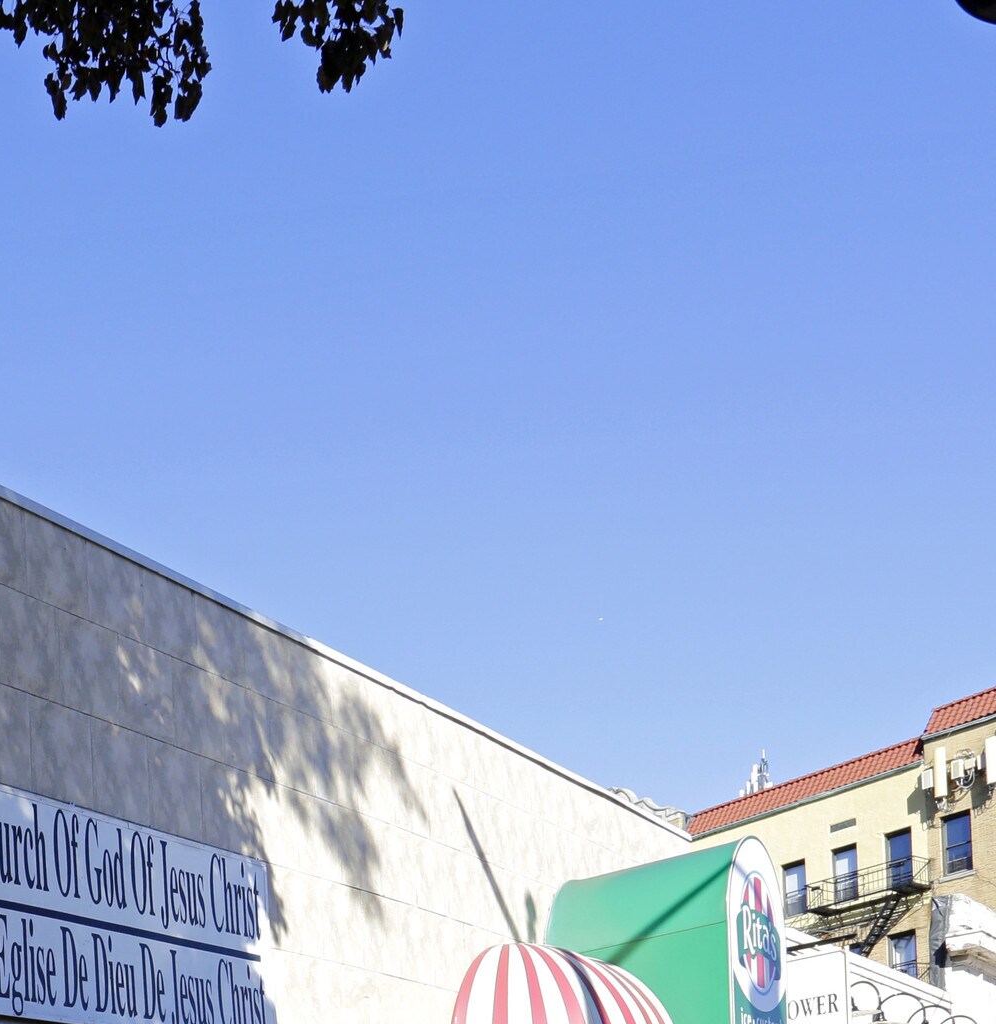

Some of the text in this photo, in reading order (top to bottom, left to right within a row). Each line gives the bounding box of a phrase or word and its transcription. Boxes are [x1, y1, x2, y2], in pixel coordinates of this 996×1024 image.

[53, 808, 81, 899] Of
[84, 817, 128, 910] God
[130, 831, 156, 917] Of
[160, 839, 207, 930] Jesus
[209, 852, 262, 941] Christ
[60, 925, 90, 1012] De
[90, 932, 139, 1018] Dieu
[139, 942, 167, 1023] De
[742, 904, 777, 961] Rita's
